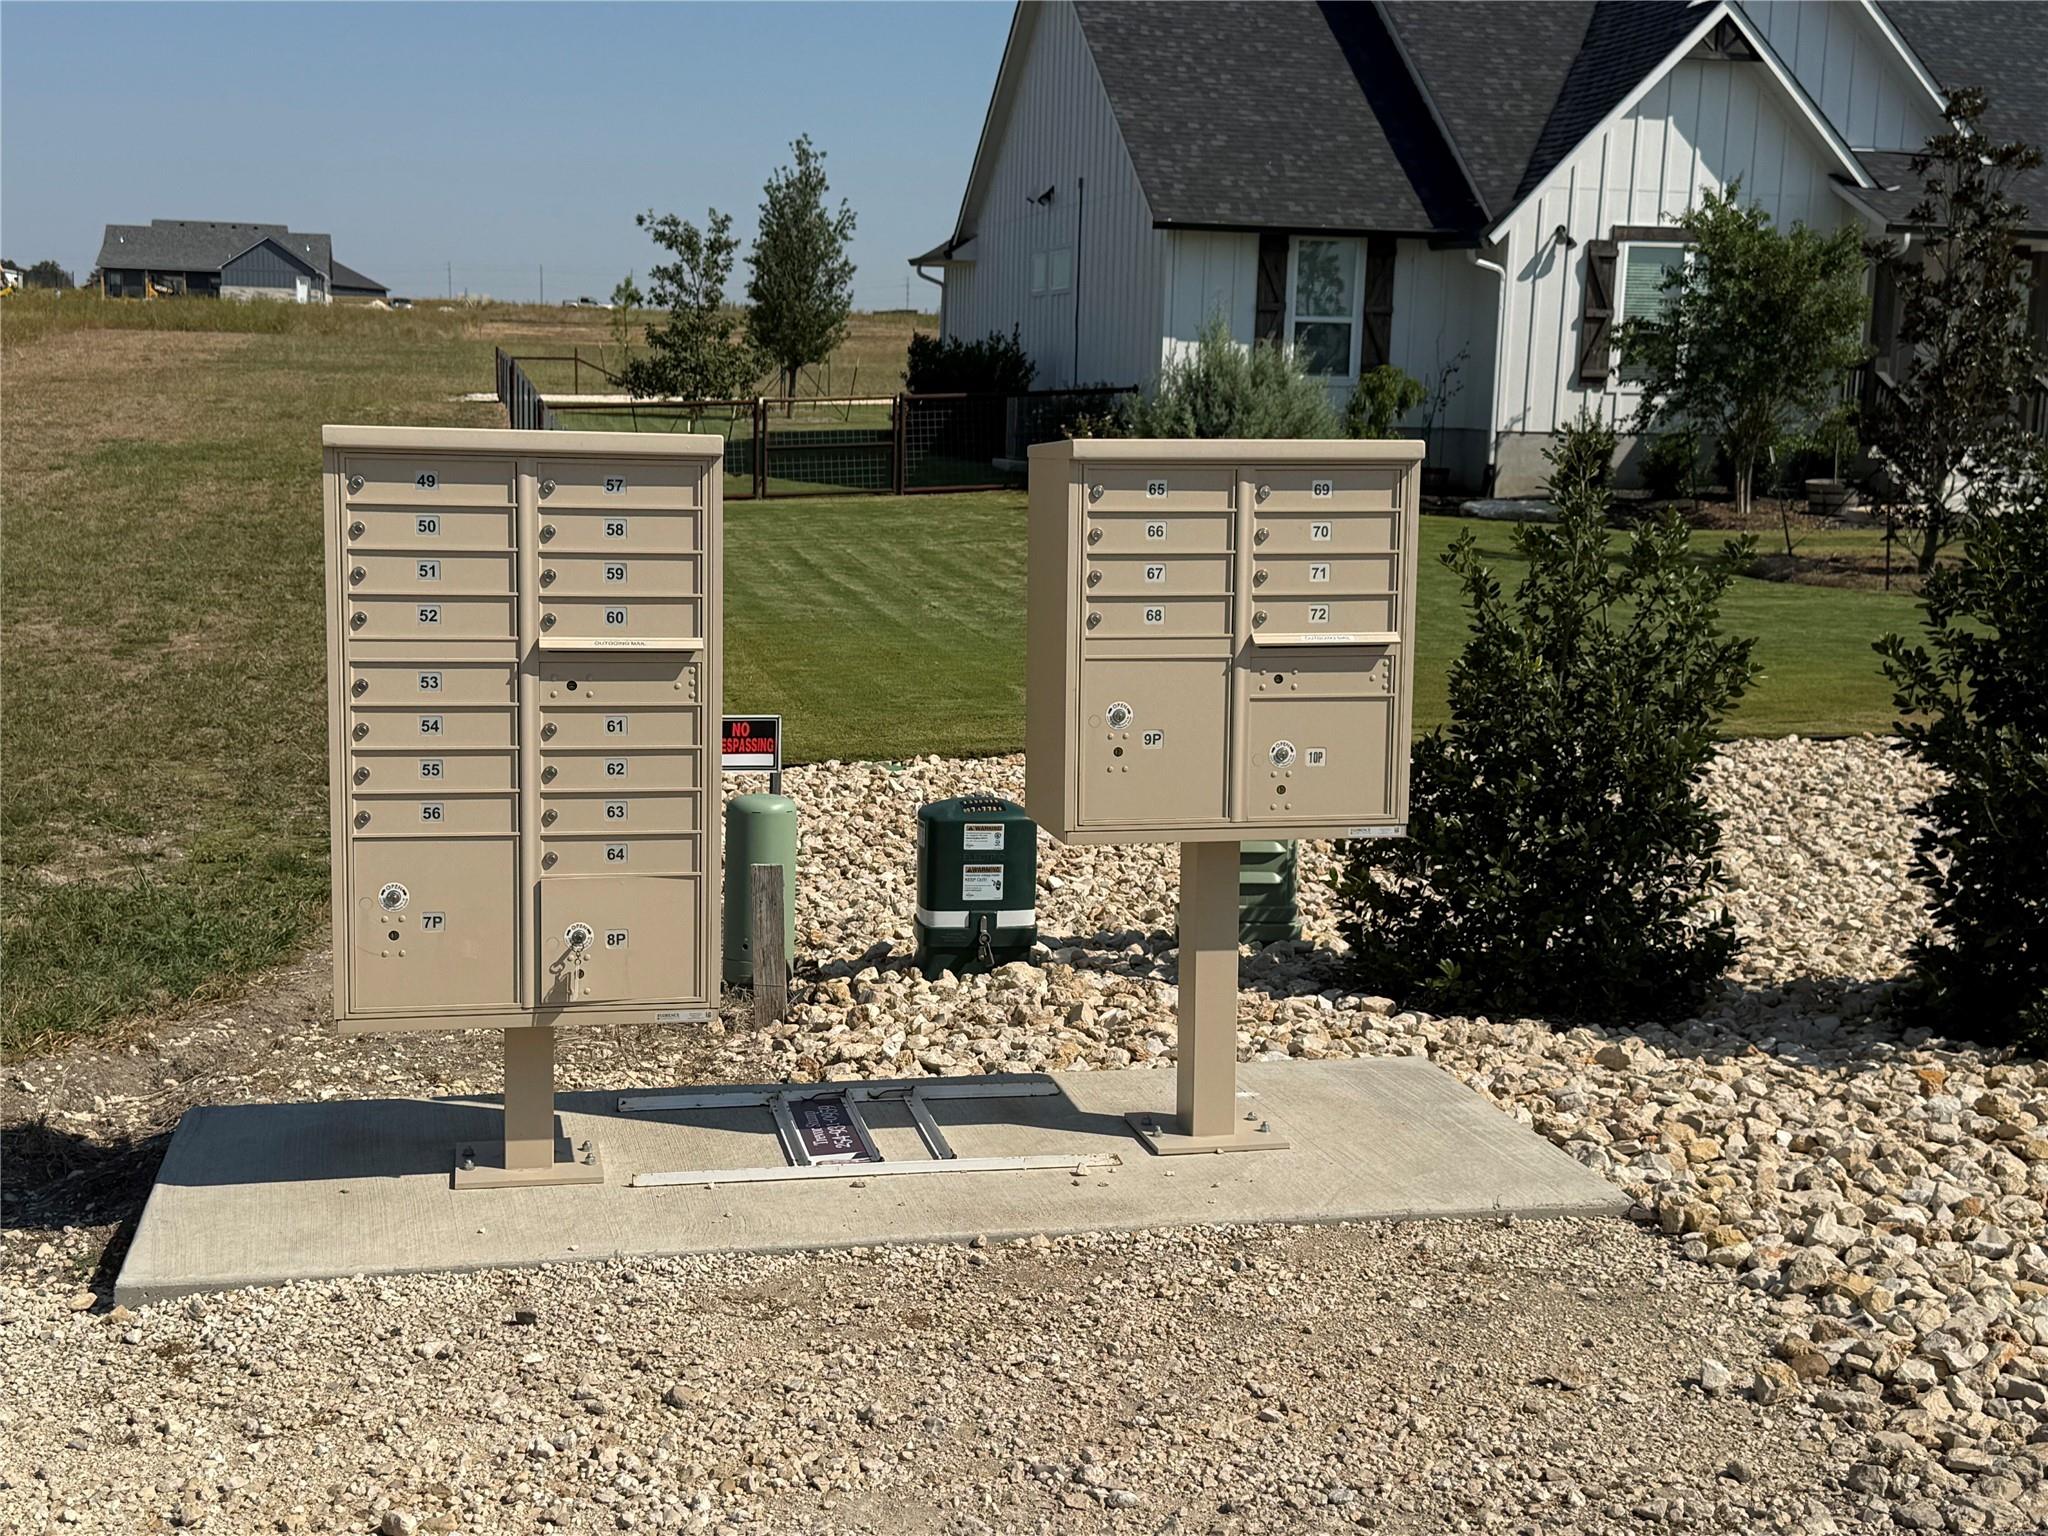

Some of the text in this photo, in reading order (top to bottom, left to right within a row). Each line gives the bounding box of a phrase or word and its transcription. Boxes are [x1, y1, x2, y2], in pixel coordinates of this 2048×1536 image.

[417, 474, 436, 488] 49
[605, 478, 624, 492] 57
[1148, 483, 1165, 496] 65
[1313, 483, 1330, 496] 69
[418, 519, 437, 533] 50
[606, 523, 624, 537] 58
[1147, 525, 1164, 538] 66
[1313, 525, 1329, 538] 70
[419, 564, 436, 578] 51
[606, 567, 625, 581] 59
[1146, 567, 1163, 580] 67
[1311, 567, 1326, 579] 71
[419, 609, 438, 623] 52
[606, 611, 624, 625] 60
[1146, 609, 1162, 622] 68
[1310, 608, 1326, 620] 72
[420, 675, 439, 689] 53
[421, 719, 440, 733] 54
[606, 719, 623, 733] 61
[732, 722, 751, 737] NO
[722, 737, 774, 753] ESPASSING
[1144, 733, 1162, 746] 9P
[1307, 751, 1324, 765] 10P
[421, 763, 441, 777] 55
[606, 762, 625, 776] 62
[422, 806, 441, 820] 56
[606, 805, 625, 818] 63
[606, 847, 625, 861] 64
[422, 915, 443, 929] 7P
[607, 933, 626, 946] 8P
